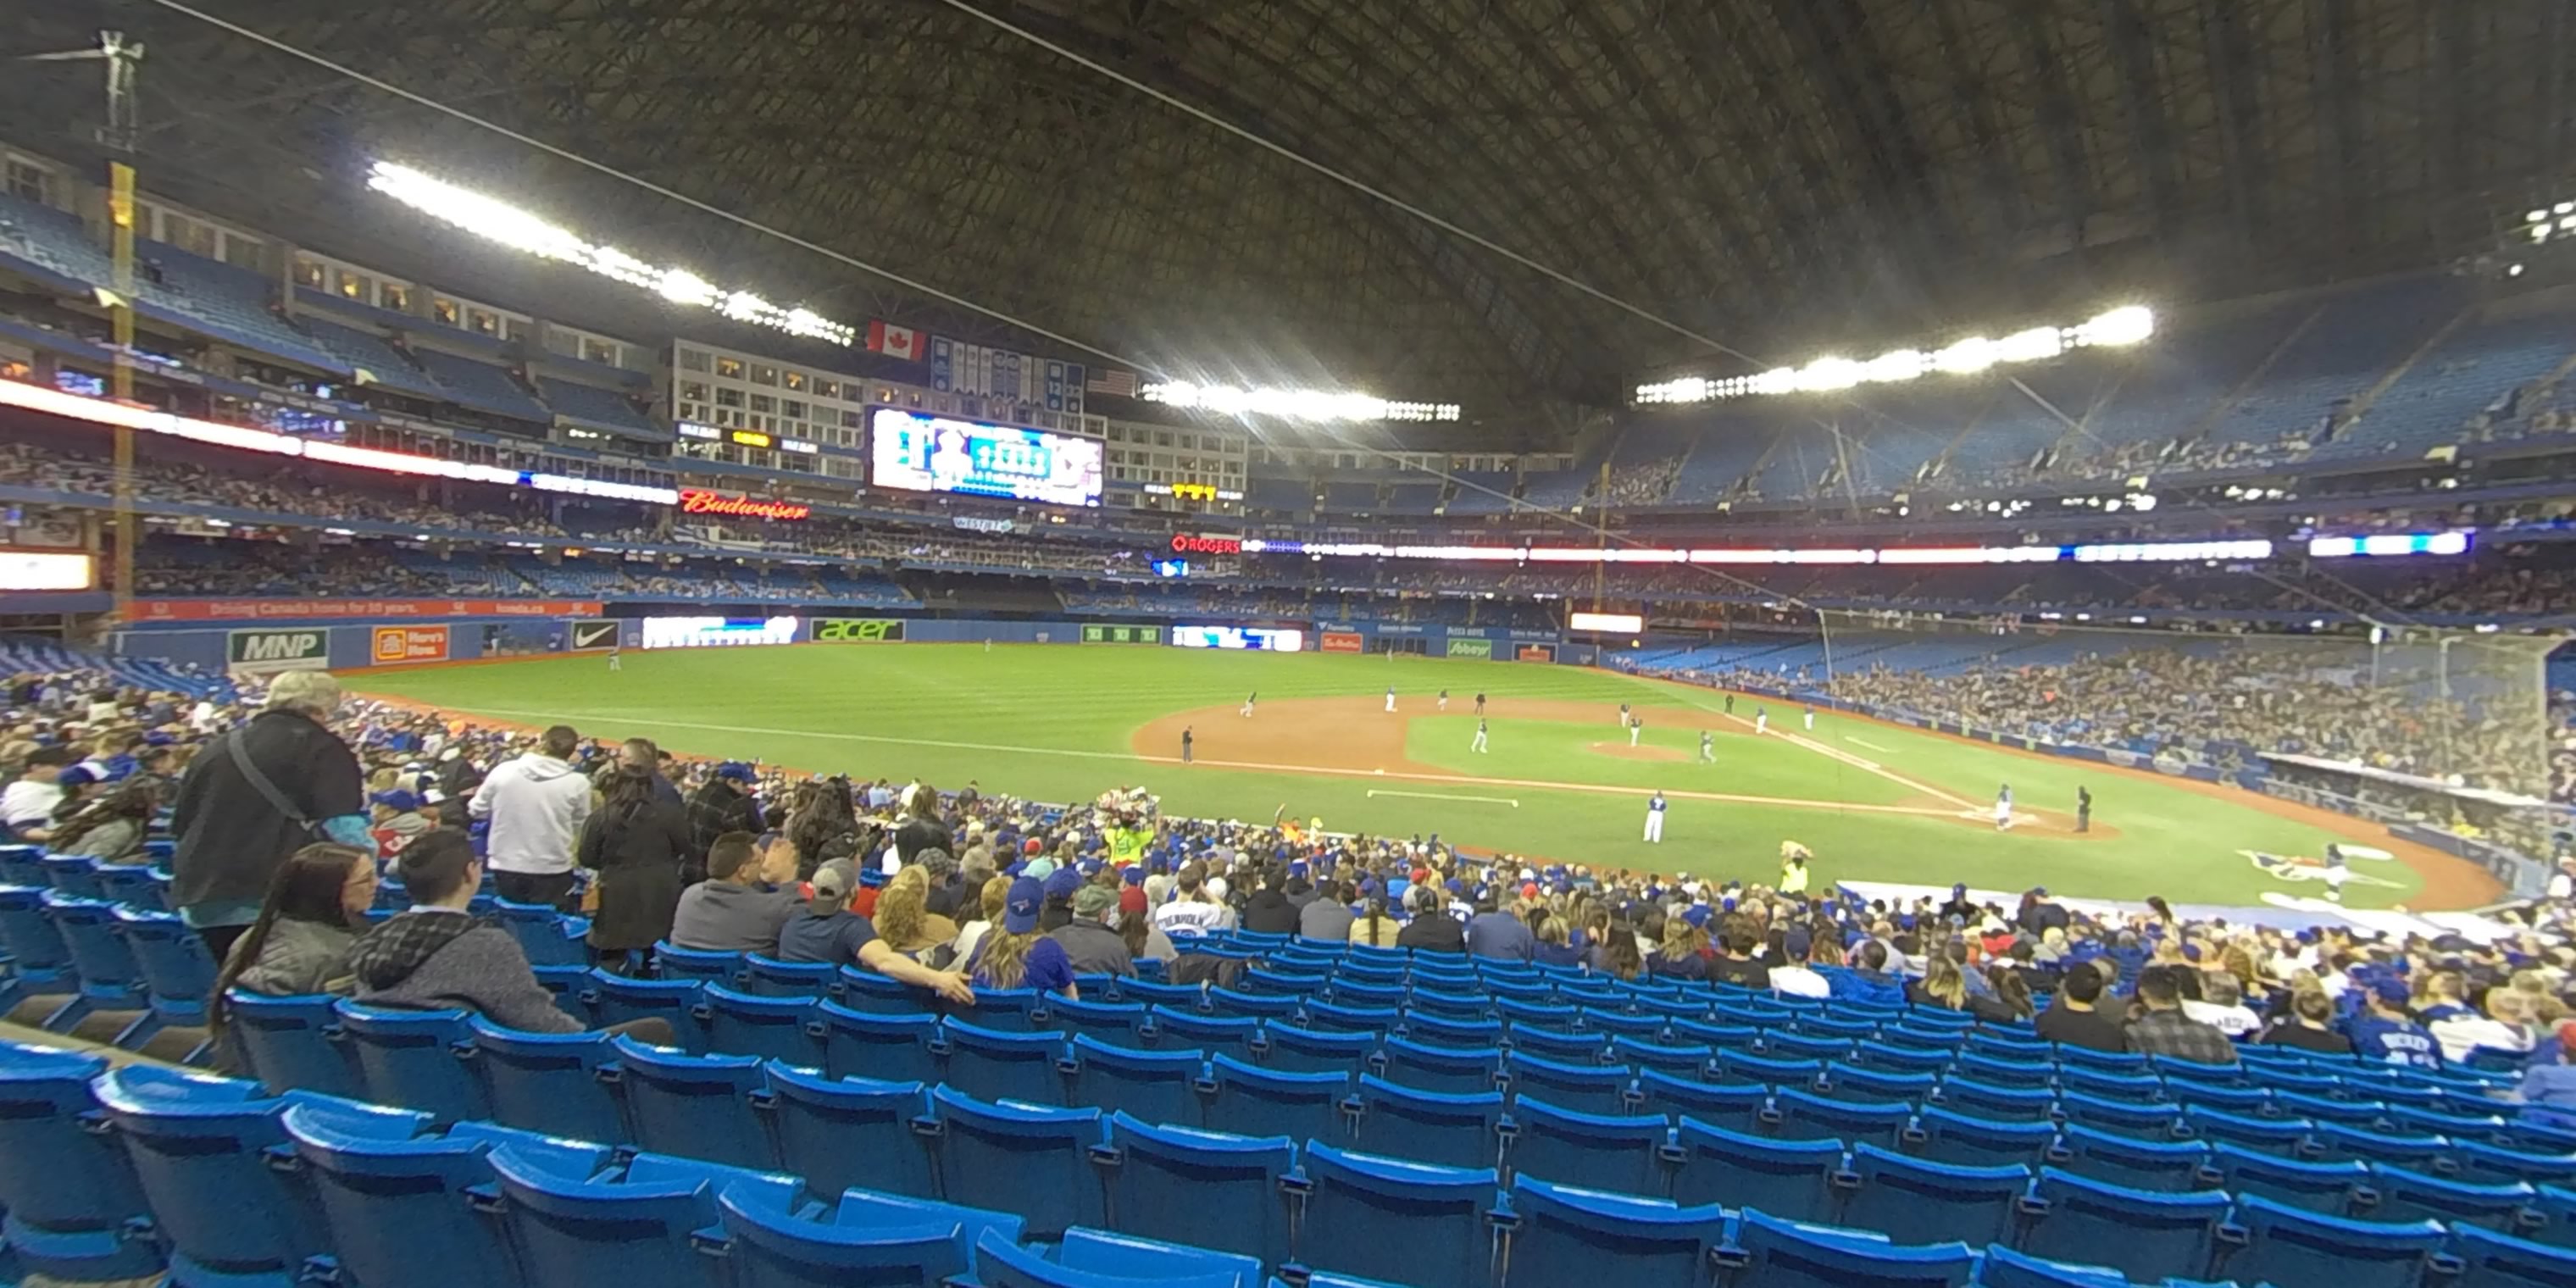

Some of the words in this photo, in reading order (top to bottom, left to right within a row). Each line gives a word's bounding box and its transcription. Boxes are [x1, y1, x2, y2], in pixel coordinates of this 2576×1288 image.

[680, 488, 810, 519] Budweiser
[1188, 538, 1240, 553] ROGERS
[210, 602, 257, 617] Driving
[259, 602, 310, 614] Canada
[312, 602, 346, 613] home
[348, 602, 364, 613] for
[496, 603, 545, 614] honda.ca
[408, 631, 444, 643] Here's
[819, 618, 898, 641] acer
[242, 634, 318, 660] MNP
